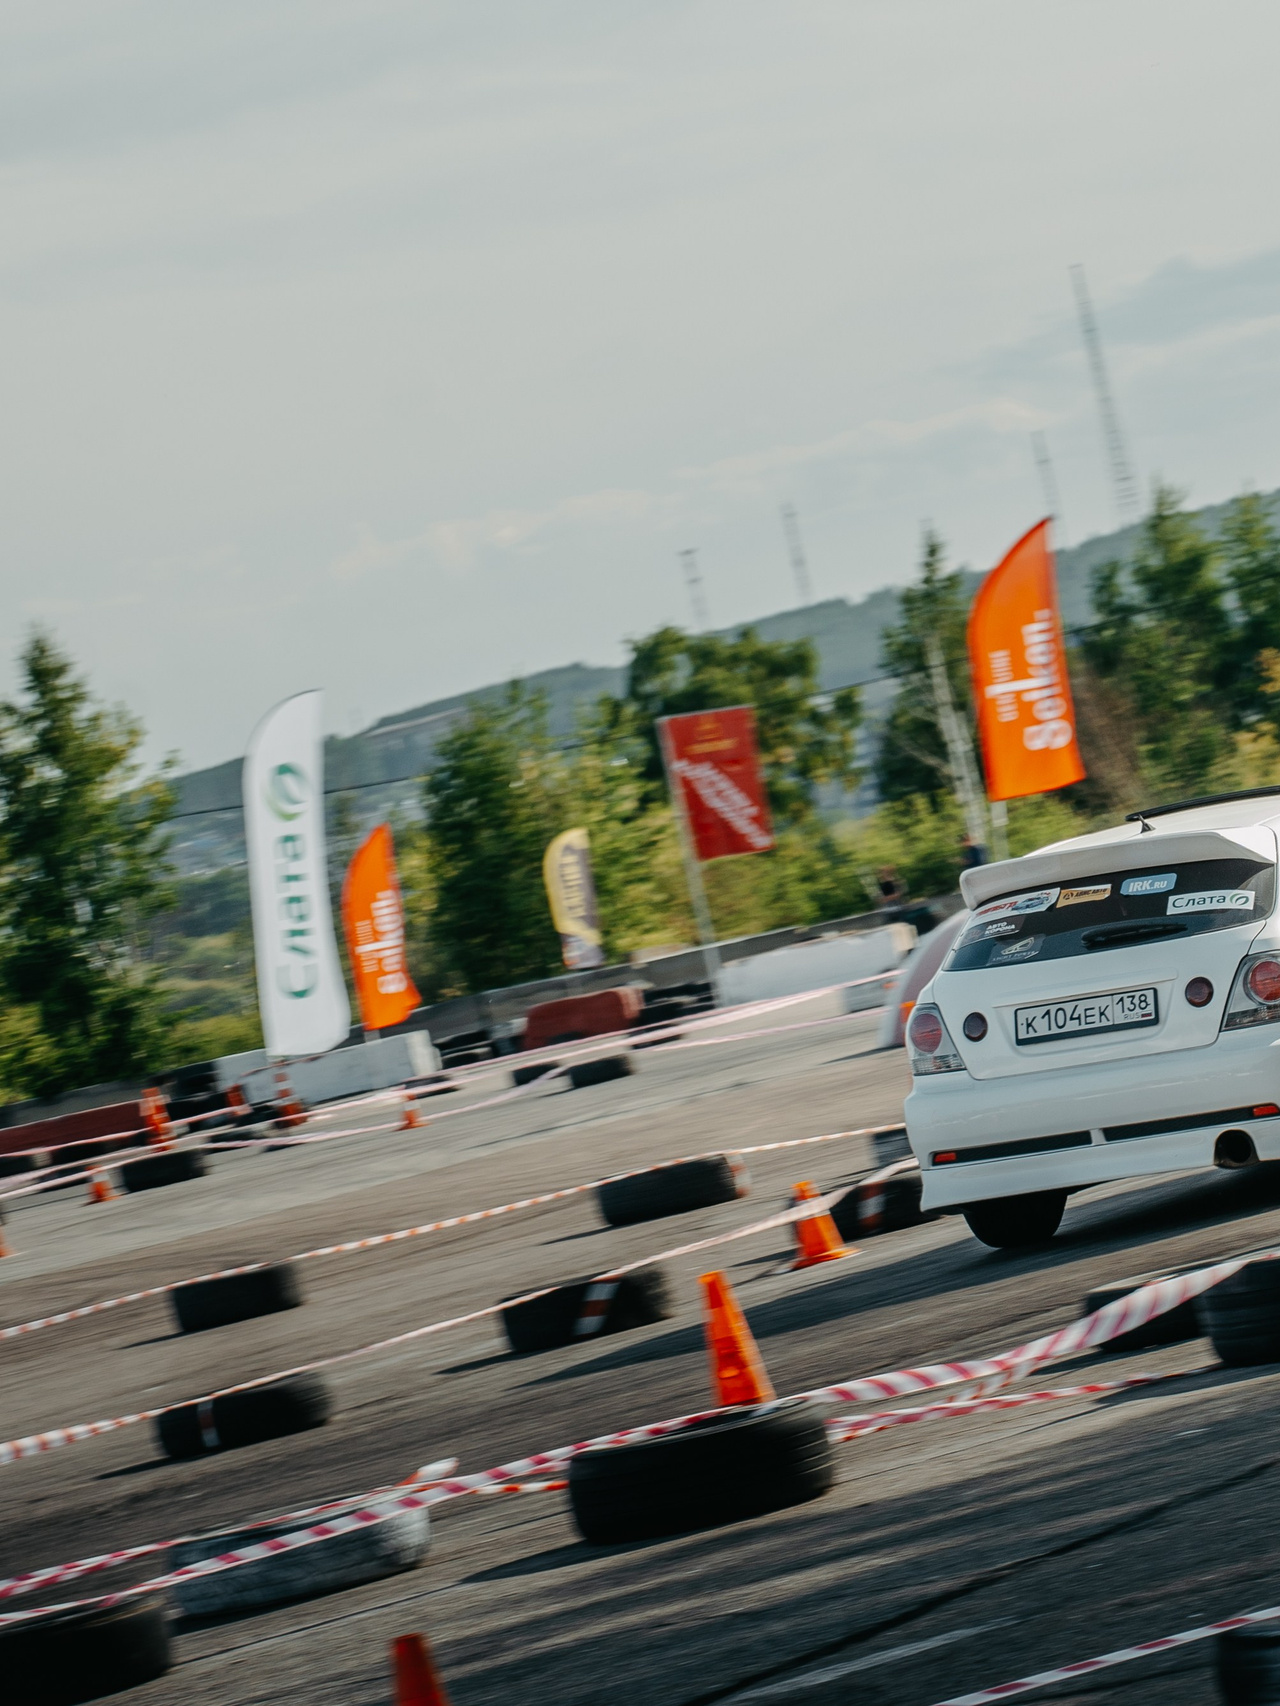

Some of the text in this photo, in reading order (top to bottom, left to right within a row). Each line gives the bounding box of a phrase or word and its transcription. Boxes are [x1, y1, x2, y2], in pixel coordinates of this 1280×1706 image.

[1128, 880, 1168, 892] IRK.RU
[1172, 895, 1226, 908] Слата
[273, 833, 319, 999] Слата
[1116, 993, 1149, 1013] 138
[1124, 1012, 1141, 1020] RUS
